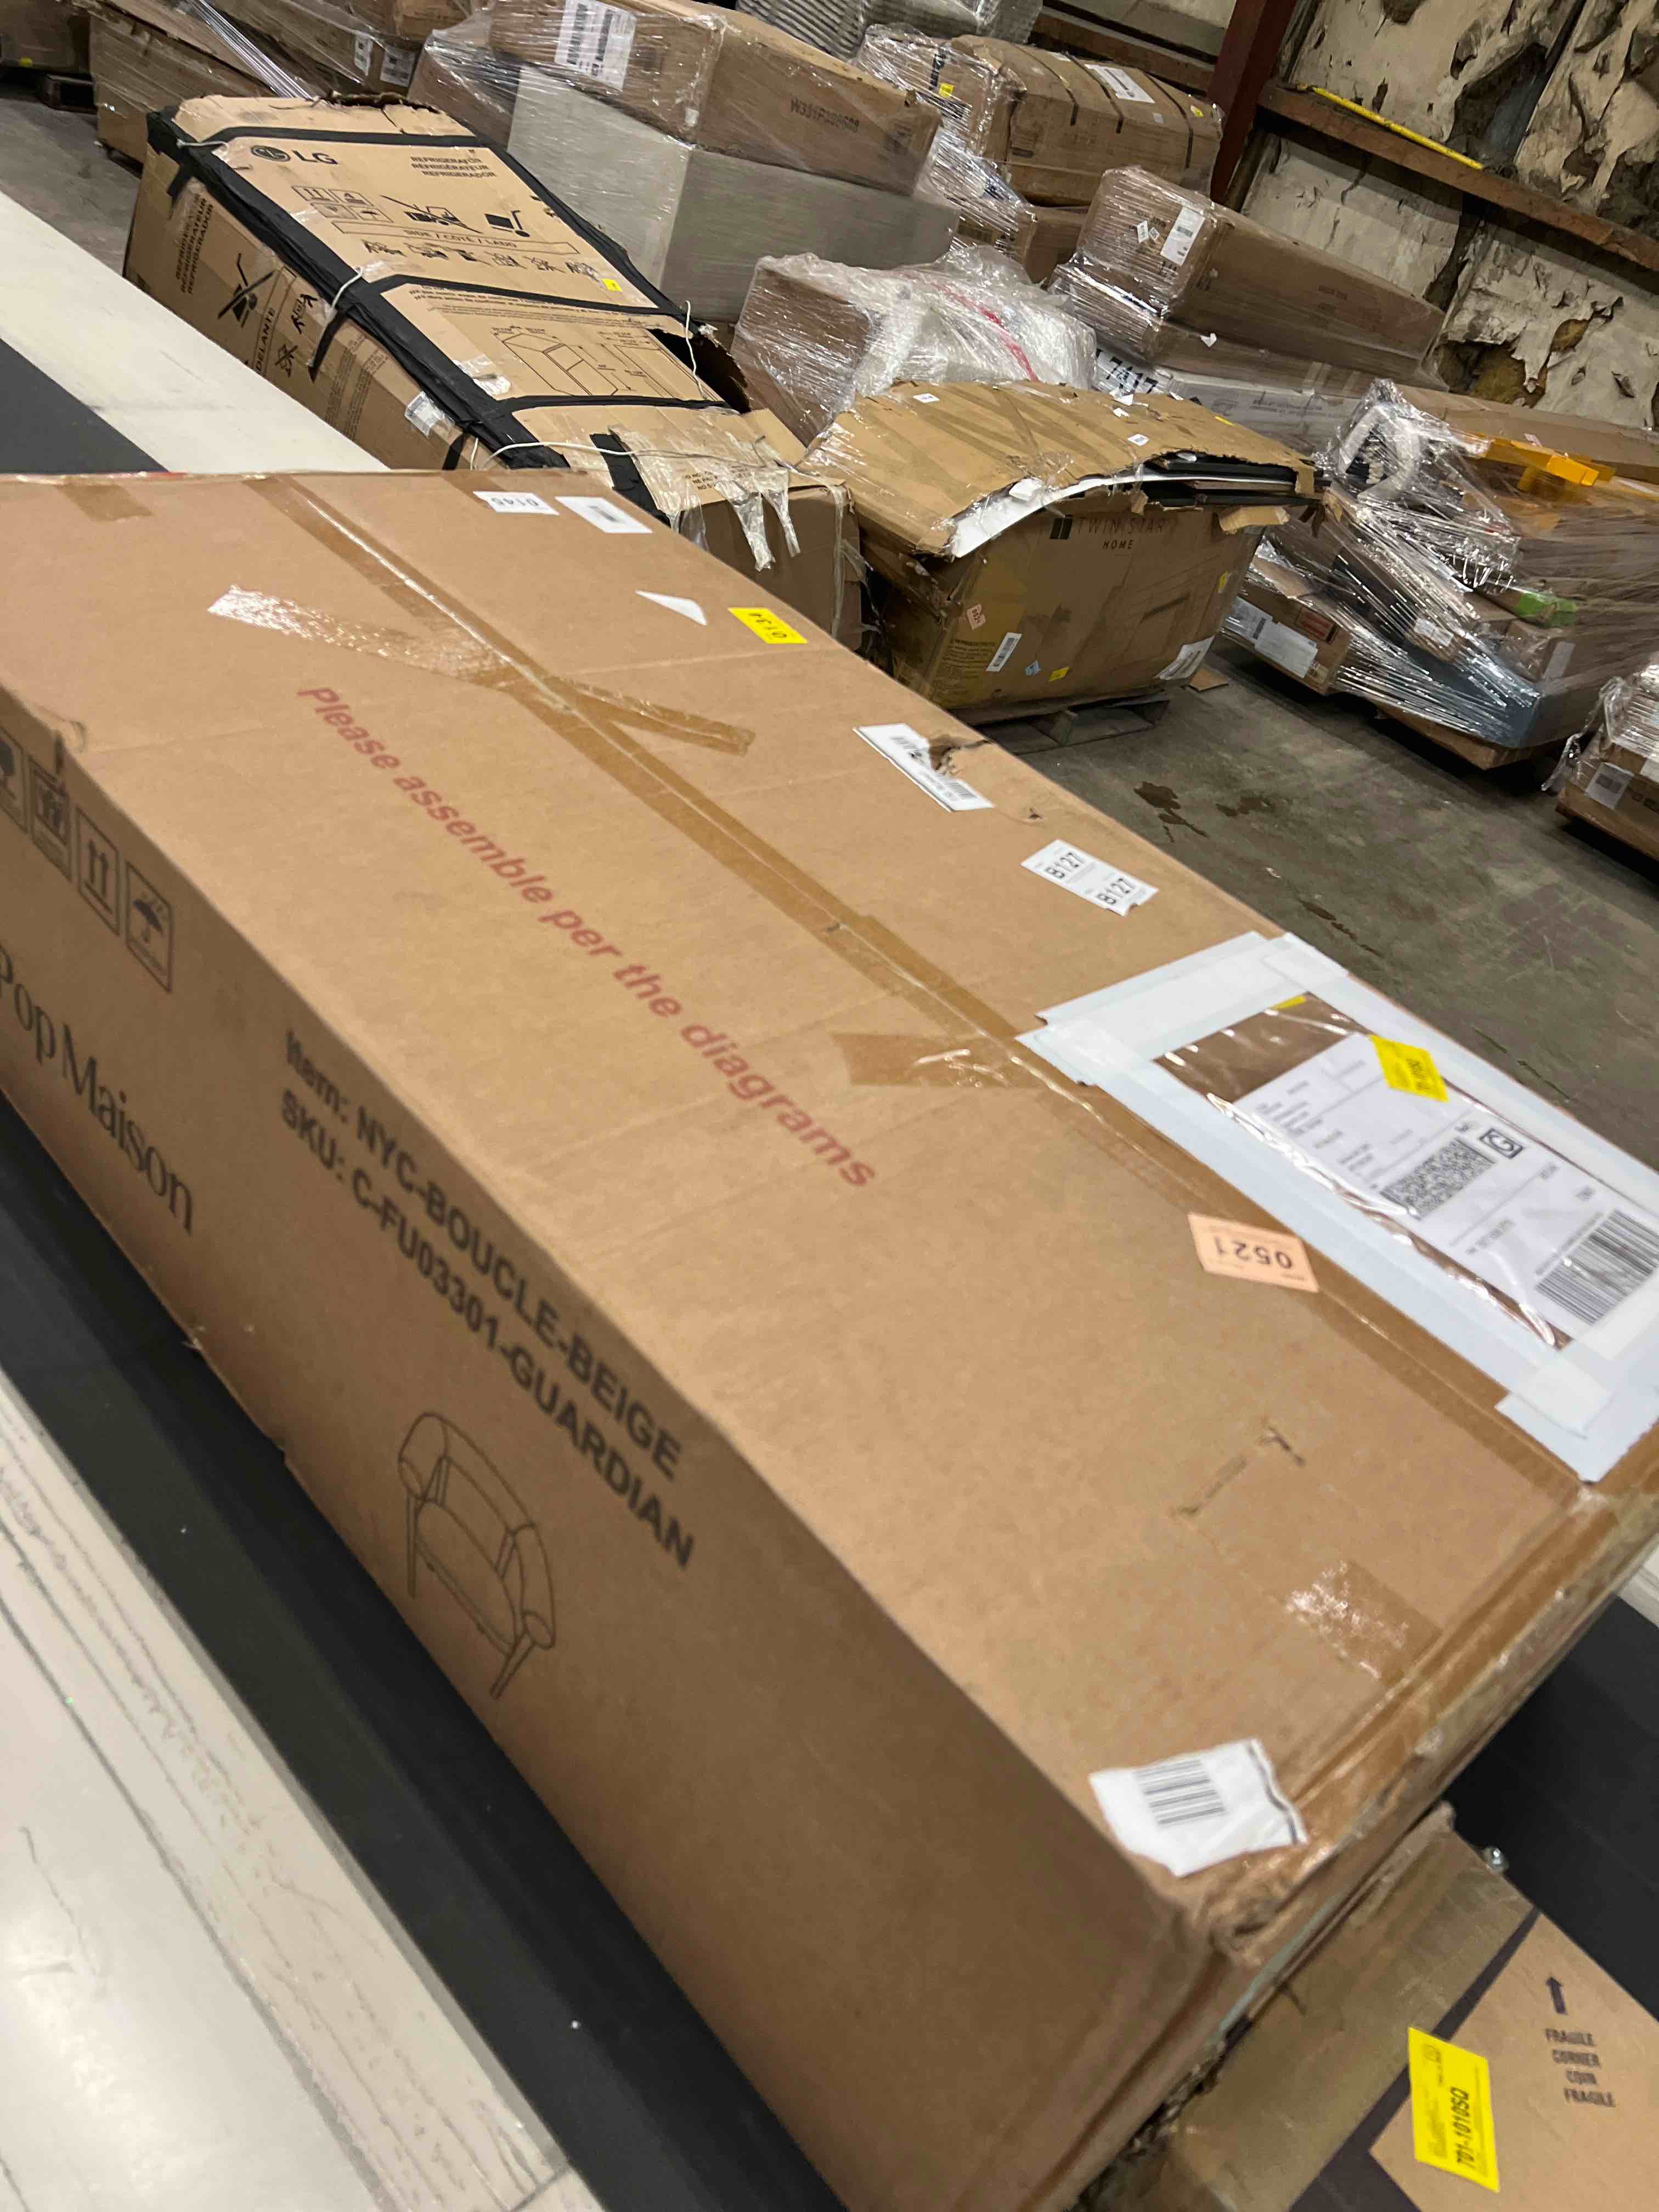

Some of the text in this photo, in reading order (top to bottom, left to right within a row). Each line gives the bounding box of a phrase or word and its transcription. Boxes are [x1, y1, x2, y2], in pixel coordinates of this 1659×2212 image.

[293, 149, 338, 165] LG
[1078, 517, 1166, 534] TWIN STAR
[1102, 539, 1134, 549] HOME
[297, 685, 875, 1187] Please assemble per the diagrams
[285, 1030, 684, 1483] Item: NYC-BOUCLE-BEIGE
[1213, 1236, 1293, 1270] 0521
[280, 1092, 696, 1570] SKU: C-FU03301-GUARDIAN
